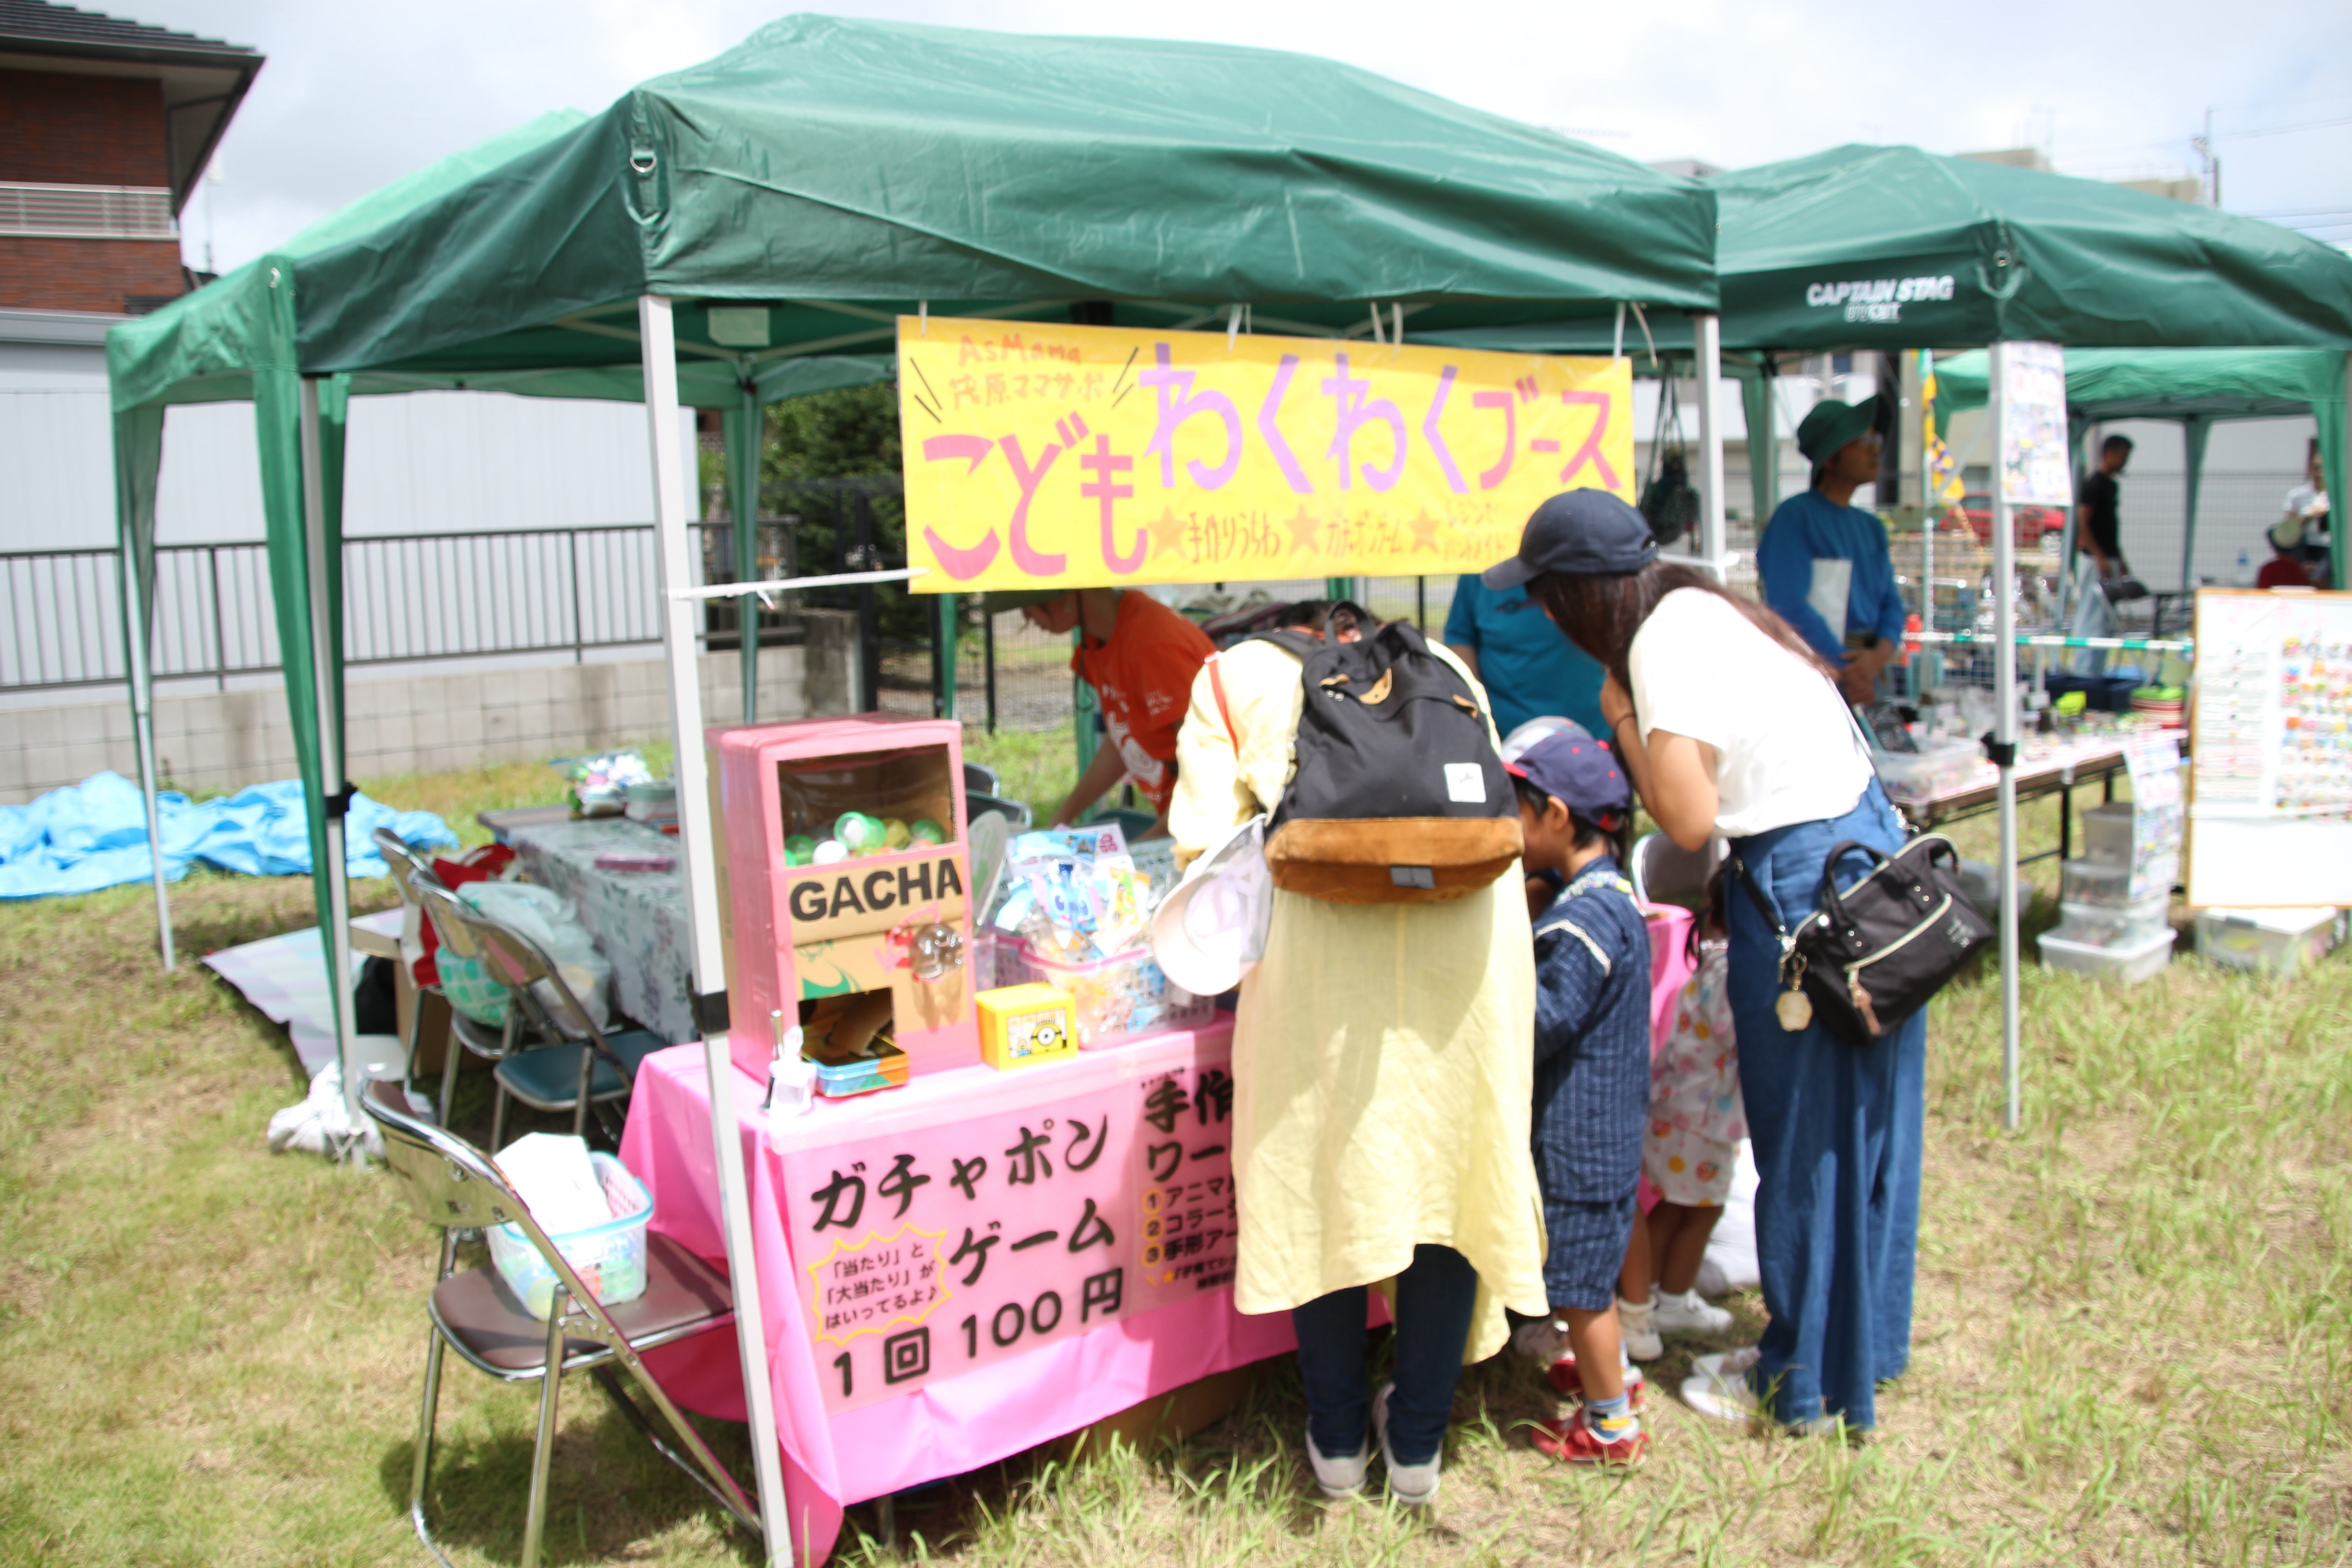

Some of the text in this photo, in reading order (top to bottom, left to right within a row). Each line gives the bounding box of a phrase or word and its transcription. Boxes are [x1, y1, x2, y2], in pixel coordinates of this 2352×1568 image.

[1807, 274, 1955, 307] CAPTAIN STAG
[958, 332, 1082, 368] AsMama
[948, 372, 1104, 411] 茂原ママサポ
[789, 859, 963, 922] GACHA
[812, 1113, 1107, 1232] ガチャポン
[949, 1198, 1116, 1287] ゲーム
[960, 1268, 1122, 1358] 100円
